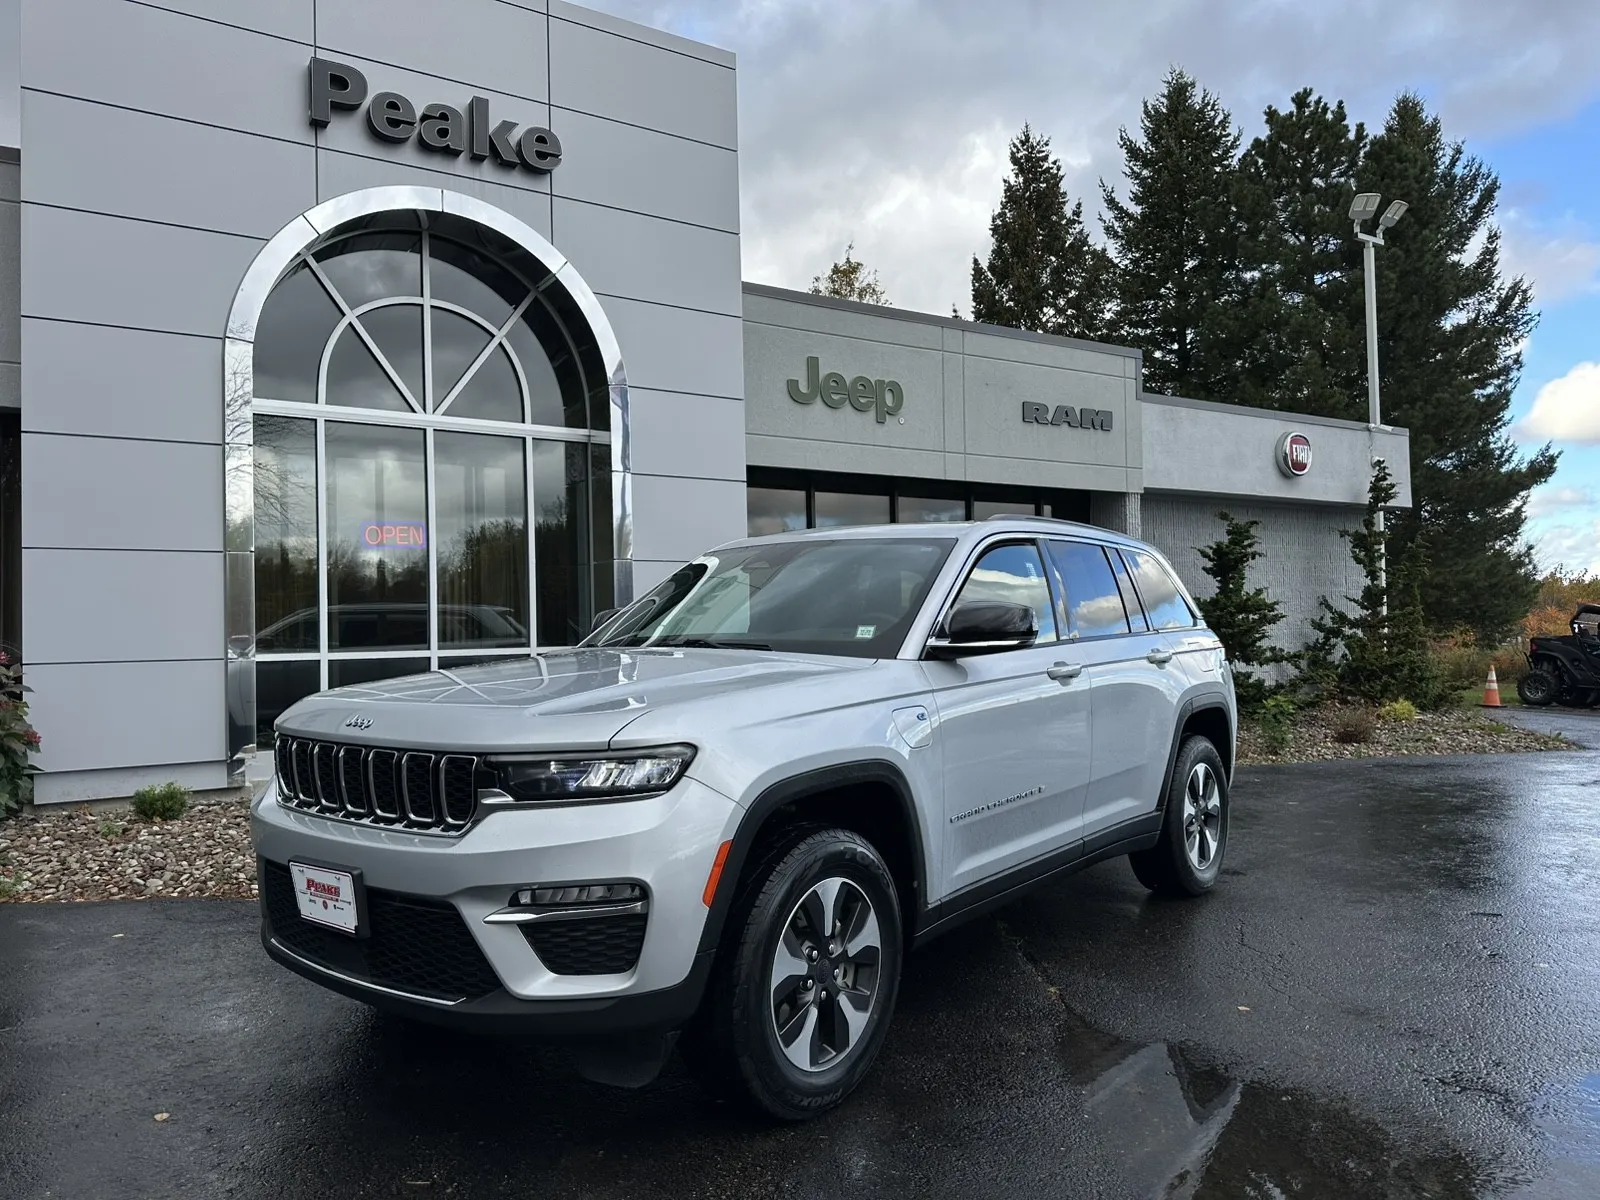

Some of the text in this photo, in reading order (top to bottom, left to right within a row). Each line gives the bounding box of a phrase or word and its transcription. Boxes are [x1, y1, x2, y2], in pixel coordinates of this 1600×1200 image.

[308, 56, 562, 174] Peake
[787, 356, 904, 424] Jeep
[1022, 401, 1113, 431] RAM
[365, 525, 423, 545] OPEN
[346, 714, 374, 731] Jeep
